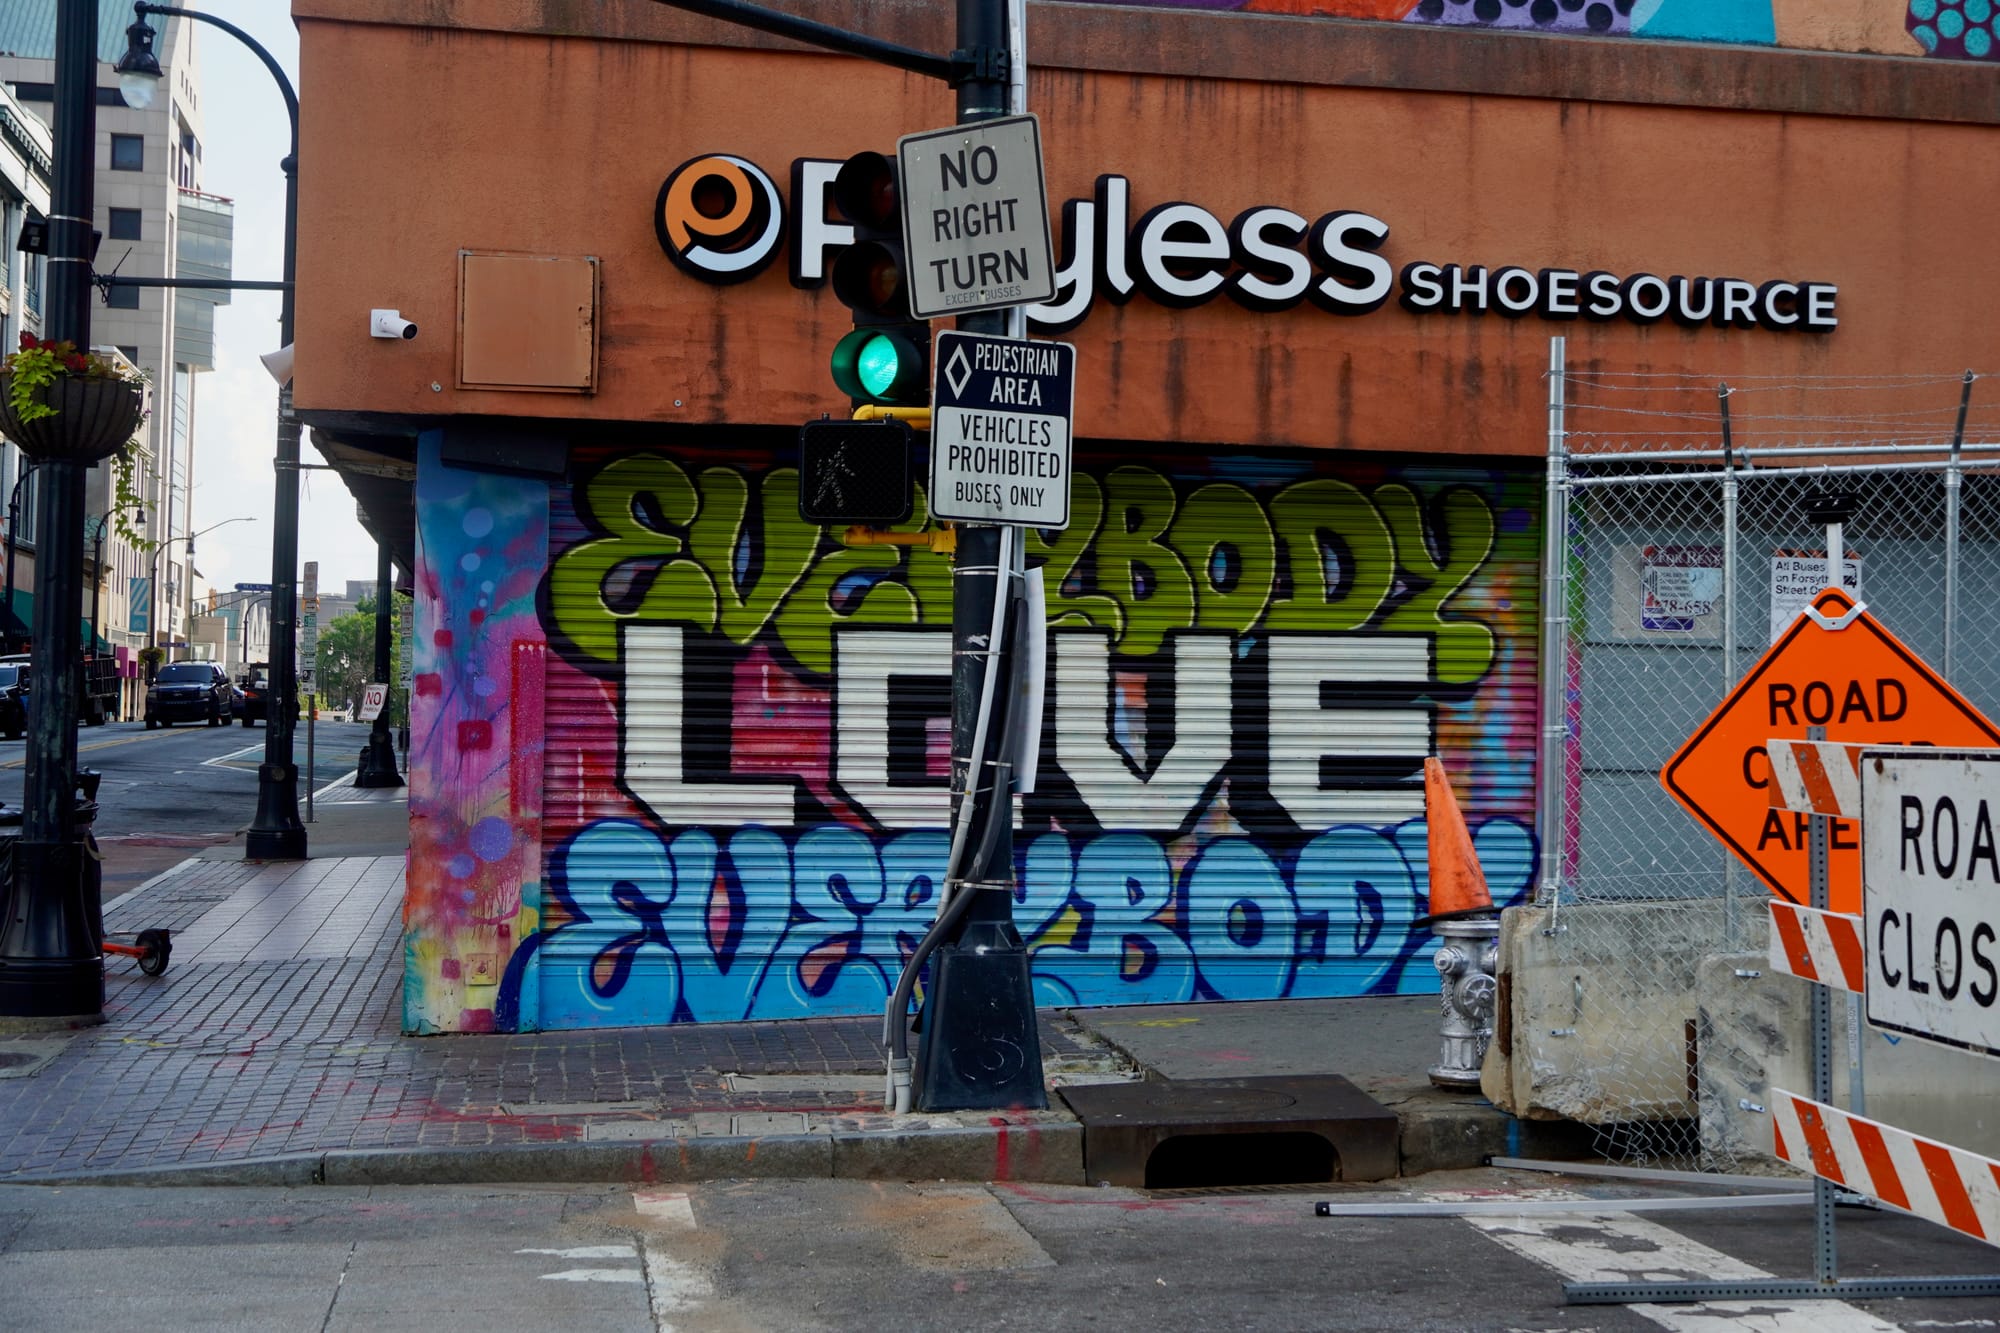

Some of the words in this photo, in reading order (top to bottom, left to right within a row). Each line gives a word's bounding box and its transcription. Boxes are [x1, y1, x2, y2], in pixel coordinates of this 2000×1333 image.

[940, 145, 998, 191] NO
[933, 198, 1018, 242] RIGHT
[800, 161, 1393, 323] Pyless
[1408, 264, 1838, 327] SHOESOURCE
[930, 248, 1029, 292] TURN
[945, 291, 980, 306] EXCEPT
[985, 285, 1022, 301] BUSSES
[975, 343, 1059, 376] PEDESTRIAN
[990, 376, 1042, 406] AREA
[960, 414, 1051, 447] VEHICLES
[949, 445, 1060, 478] PROHIBITED
[956, 482, 1001, 504] BUSES
[1010, 486, 1044, 507] ONLY
[540, 453, 1496, 704] EVEYBODY
[1775, 561, 1790, 571] All
[1793, 561, 1826, 571] Buses
[1775, 575, 1789, 583] on
[365, 691, 382, 706] NO
[1768, 678, 1907, 726] ROAD
[1901, 795, 2000, 883] ROA
[1879, 908, 1998, 1007] CLOS
